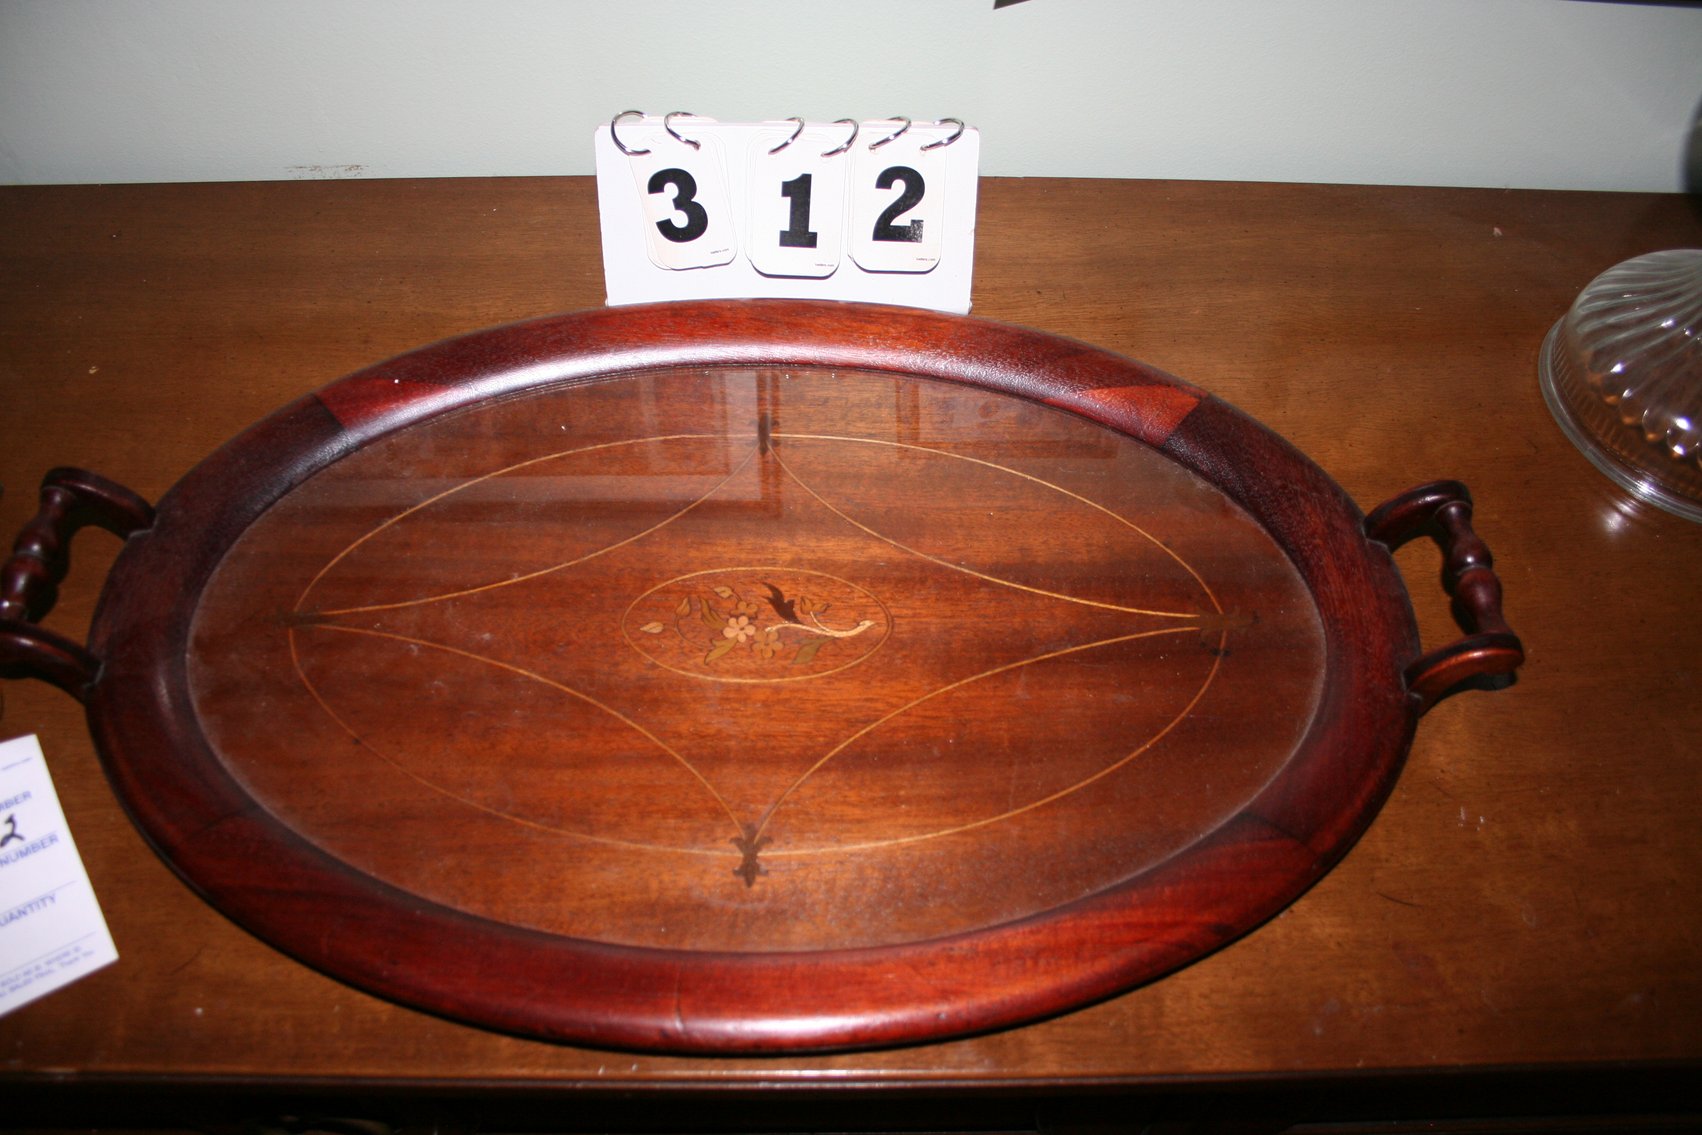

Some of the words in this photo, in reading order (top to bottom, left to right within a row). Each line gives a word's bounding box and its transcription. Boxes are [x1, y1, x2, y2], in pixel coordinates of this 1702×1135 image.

[648, 168, 708, 243] 3
[779, 173, 818, 248] 1
[872, 166, 926, 243] 2
